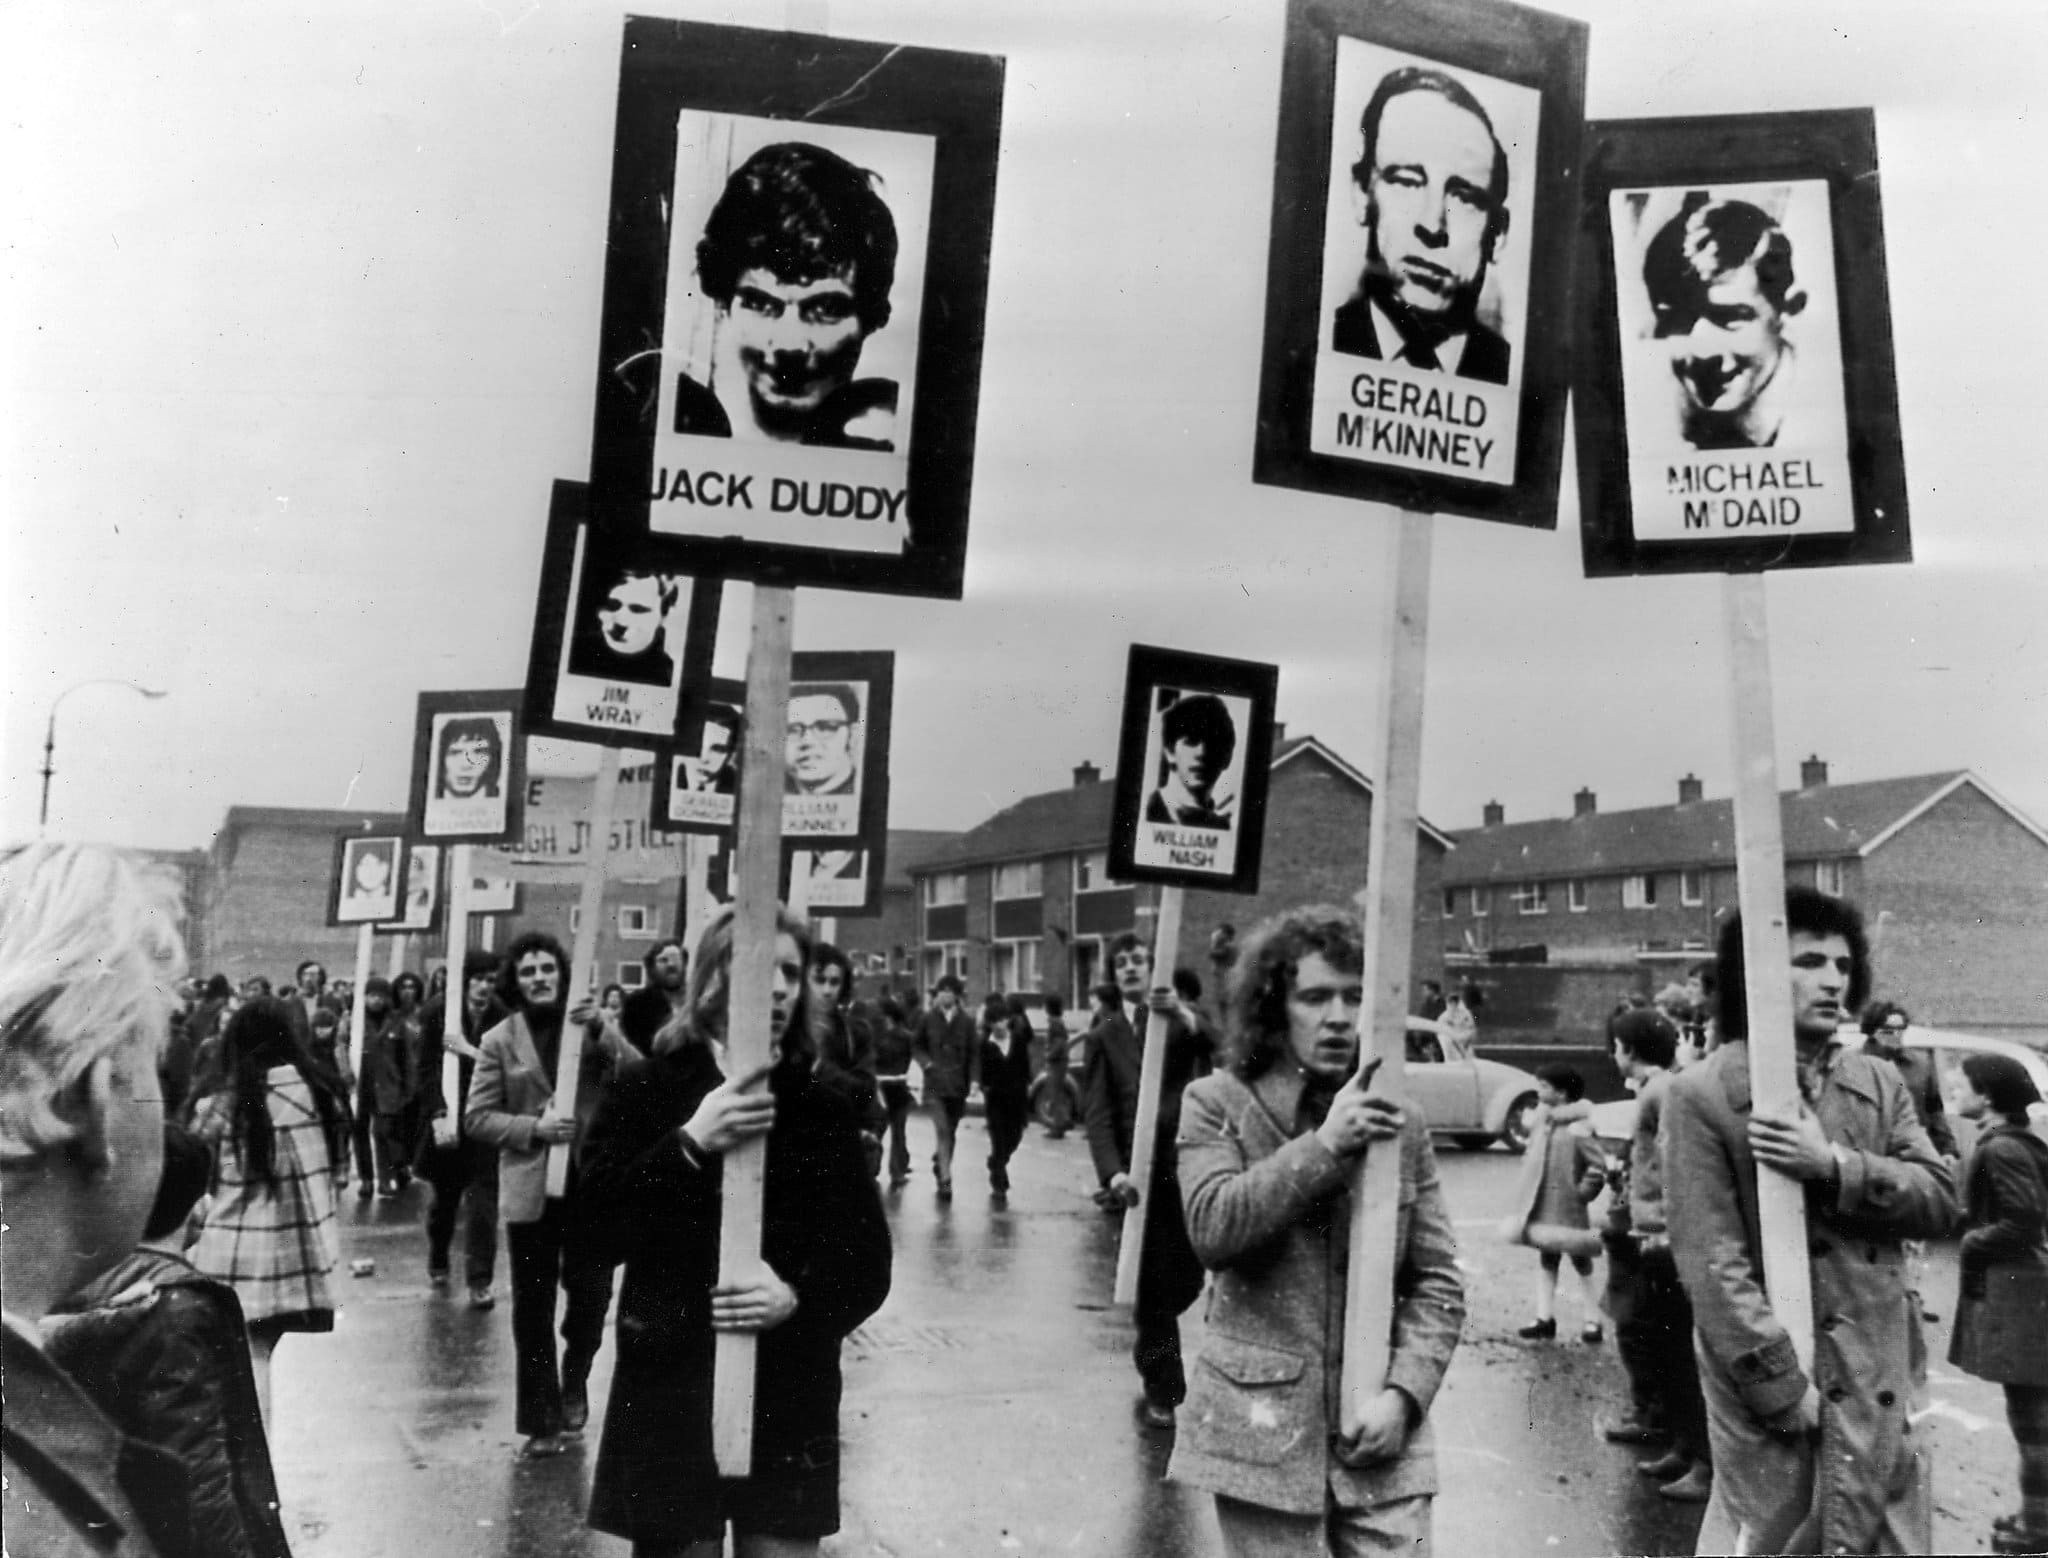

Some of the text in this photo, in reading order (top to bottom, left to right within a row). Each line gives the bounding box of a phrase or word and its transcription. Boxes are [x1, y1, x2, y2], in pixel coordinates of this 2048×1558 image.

[1351, 373, 1487, 428] GERALD
[1667, 460, 1824, 494] MICHAEL
[651, 467, 907, 523] JACK DUDDY
[602, 686, 630, 702] JIM
[586, 703, 641, 725] WRAY
[1153, 830, 1219, 851] WILLIAM
[1169, 849, 1215, 868] NASH
